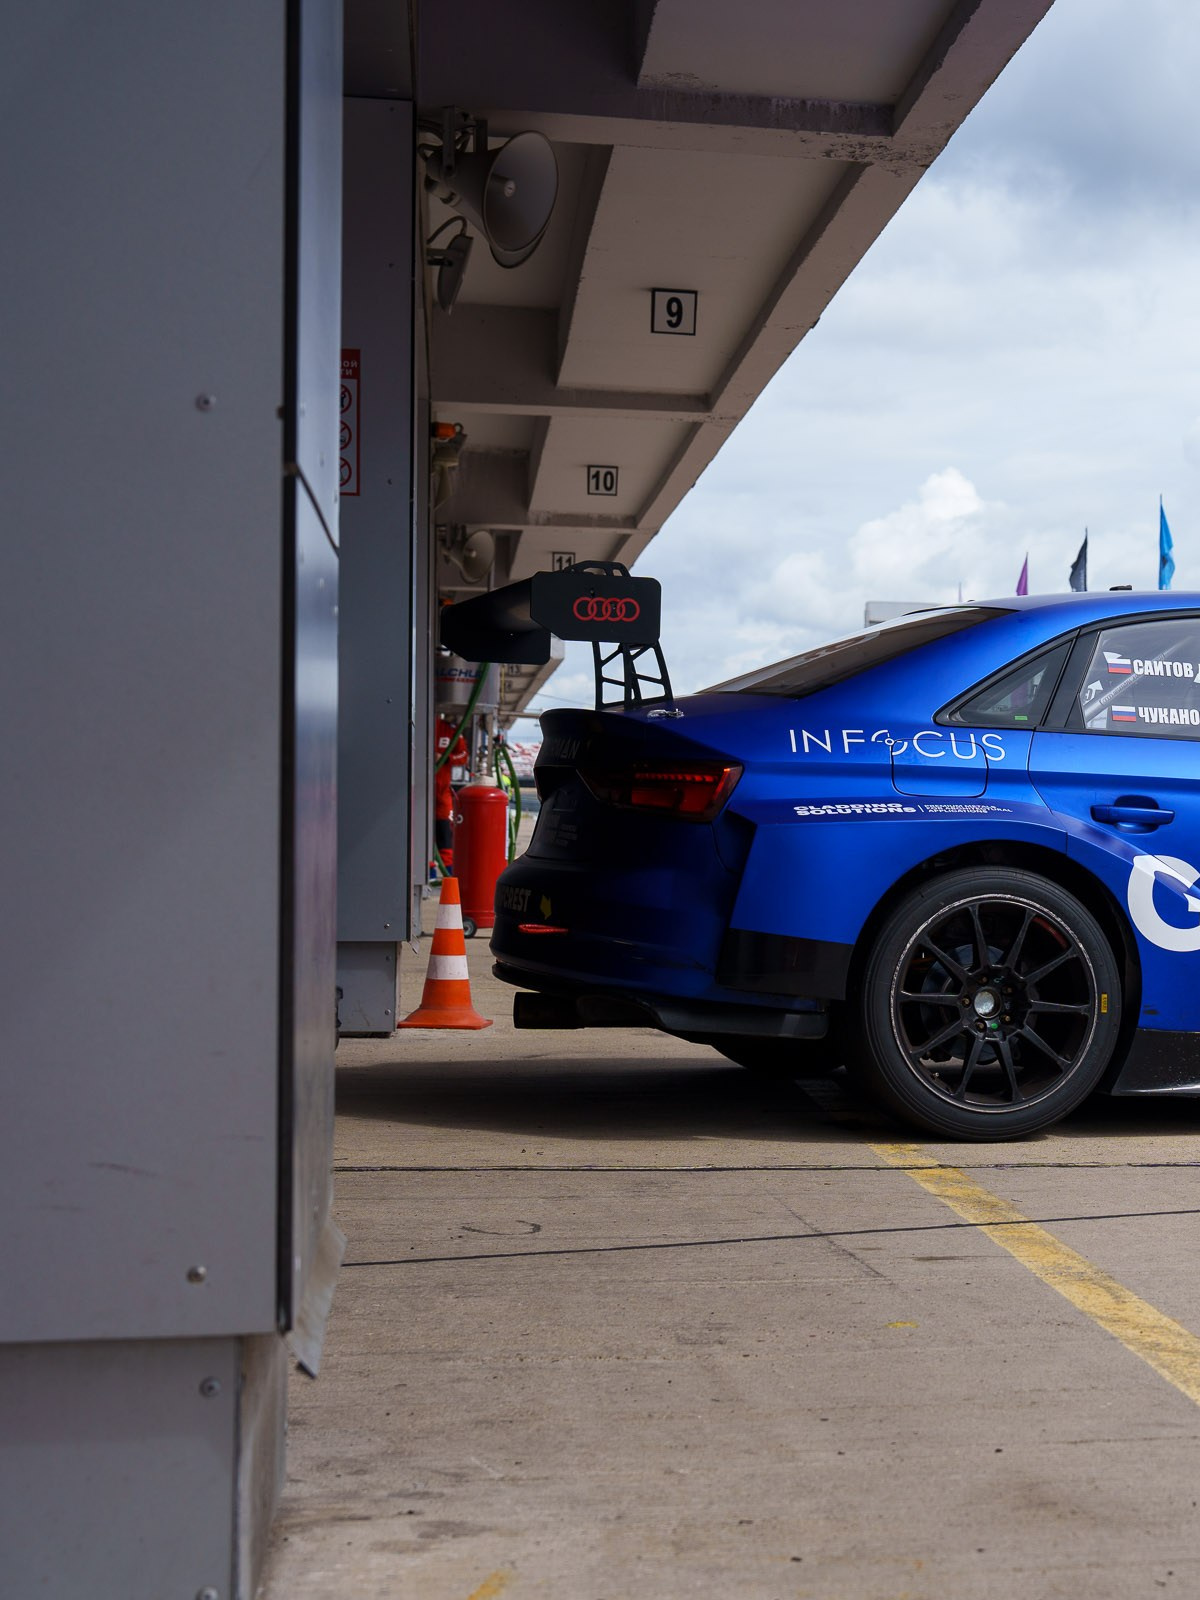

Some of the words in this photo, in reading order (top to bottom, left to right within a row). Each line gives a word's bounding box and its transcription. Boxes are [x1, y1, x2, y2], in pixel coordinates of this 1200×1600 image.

[666, 296, 683, 328] 9
[591, 470, 615, 491] 10
[789, 729, 1006, 761] INFOCUS
[793, 803, 904, 811] CLADDING
[796, 807, 917, 816] SOLUTIONS
